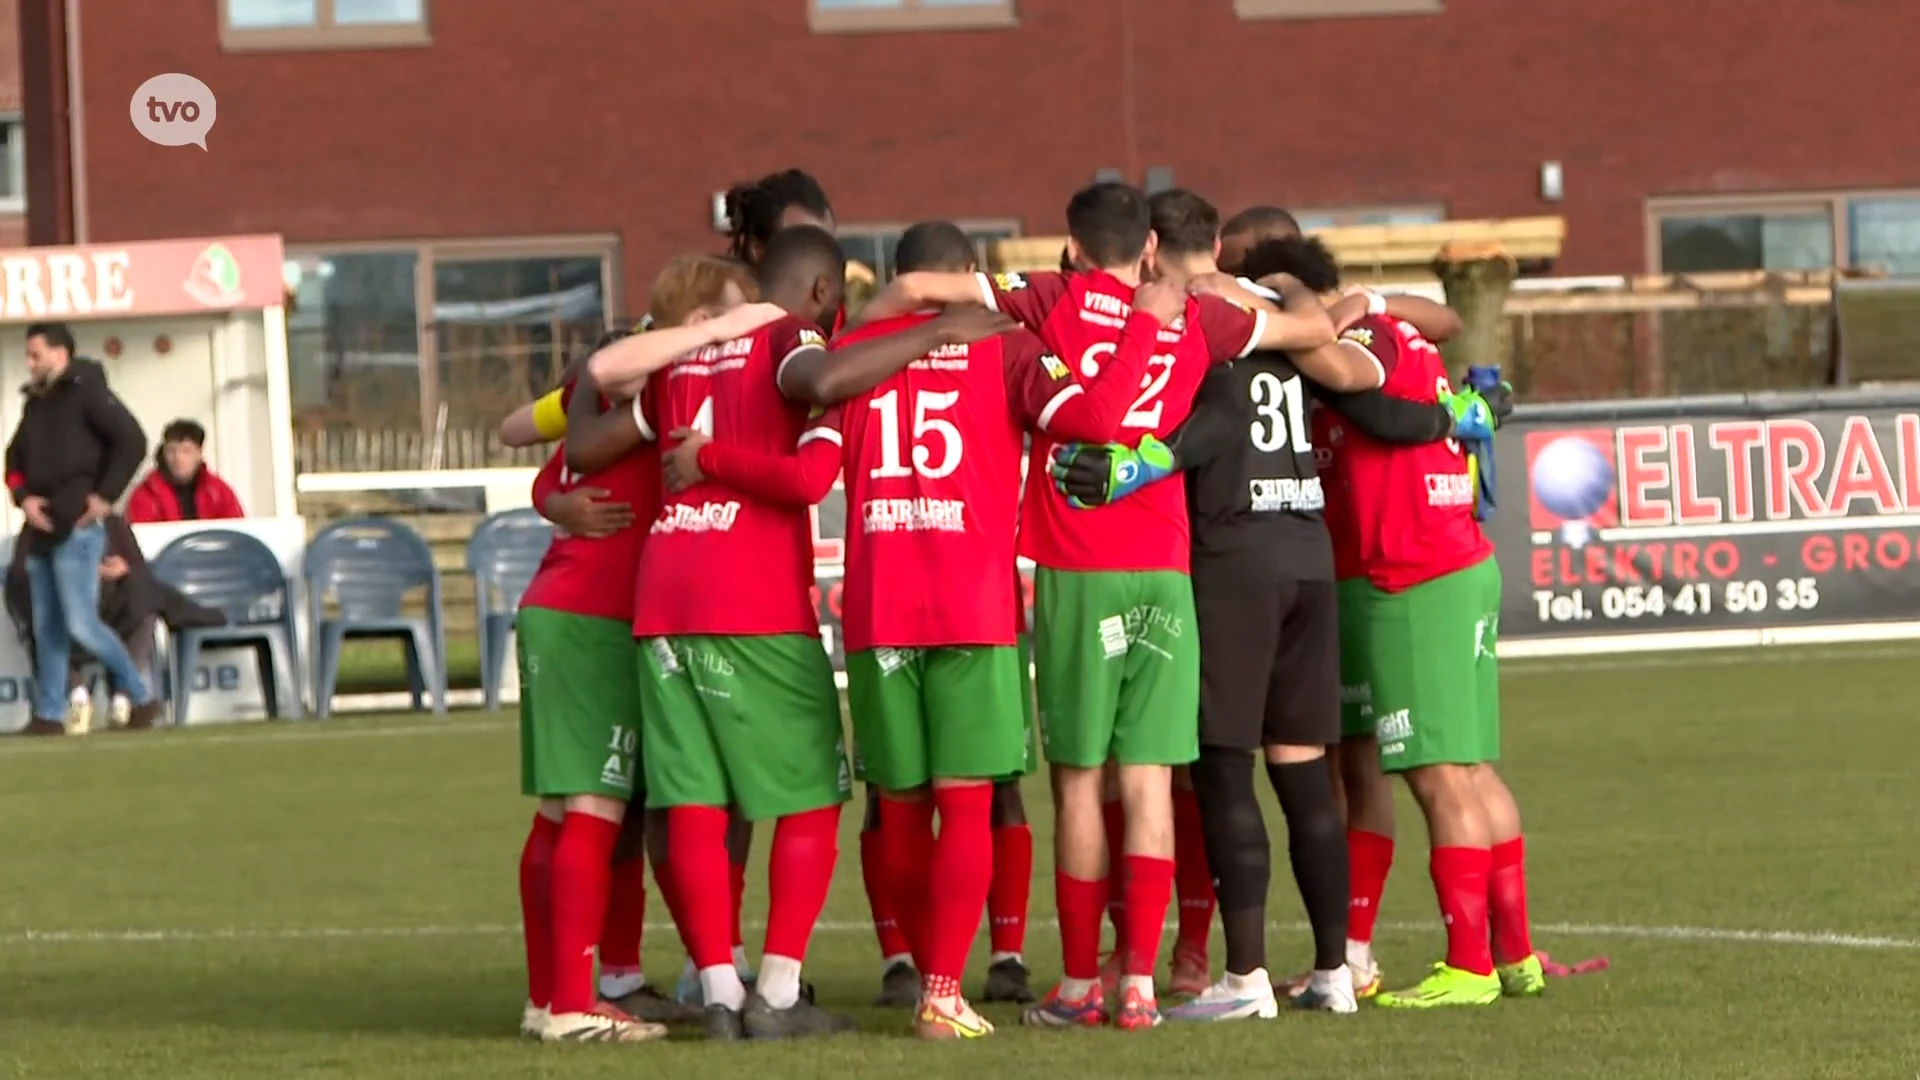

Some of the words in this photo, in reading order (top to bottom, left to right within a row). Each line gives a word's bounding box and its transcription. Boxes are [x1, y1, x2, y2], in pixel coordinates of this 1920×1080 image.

[0, 251, 133, 316] RRE
[869, 390, 963, 479] 15
[1250, 372, 1312, 453] 31
[1531, 540, 1740, 586] ELEKTRO
[1801, 528, 1920, 574] GRO
[1533, 588, 1592, 622] Tel.
[1602, 585, 1666, 619] 054
[1673, 582, 1712, 616] 41
[1725, 579, 1768, 613] 50
[1776, 577, 1819, 611] 35
